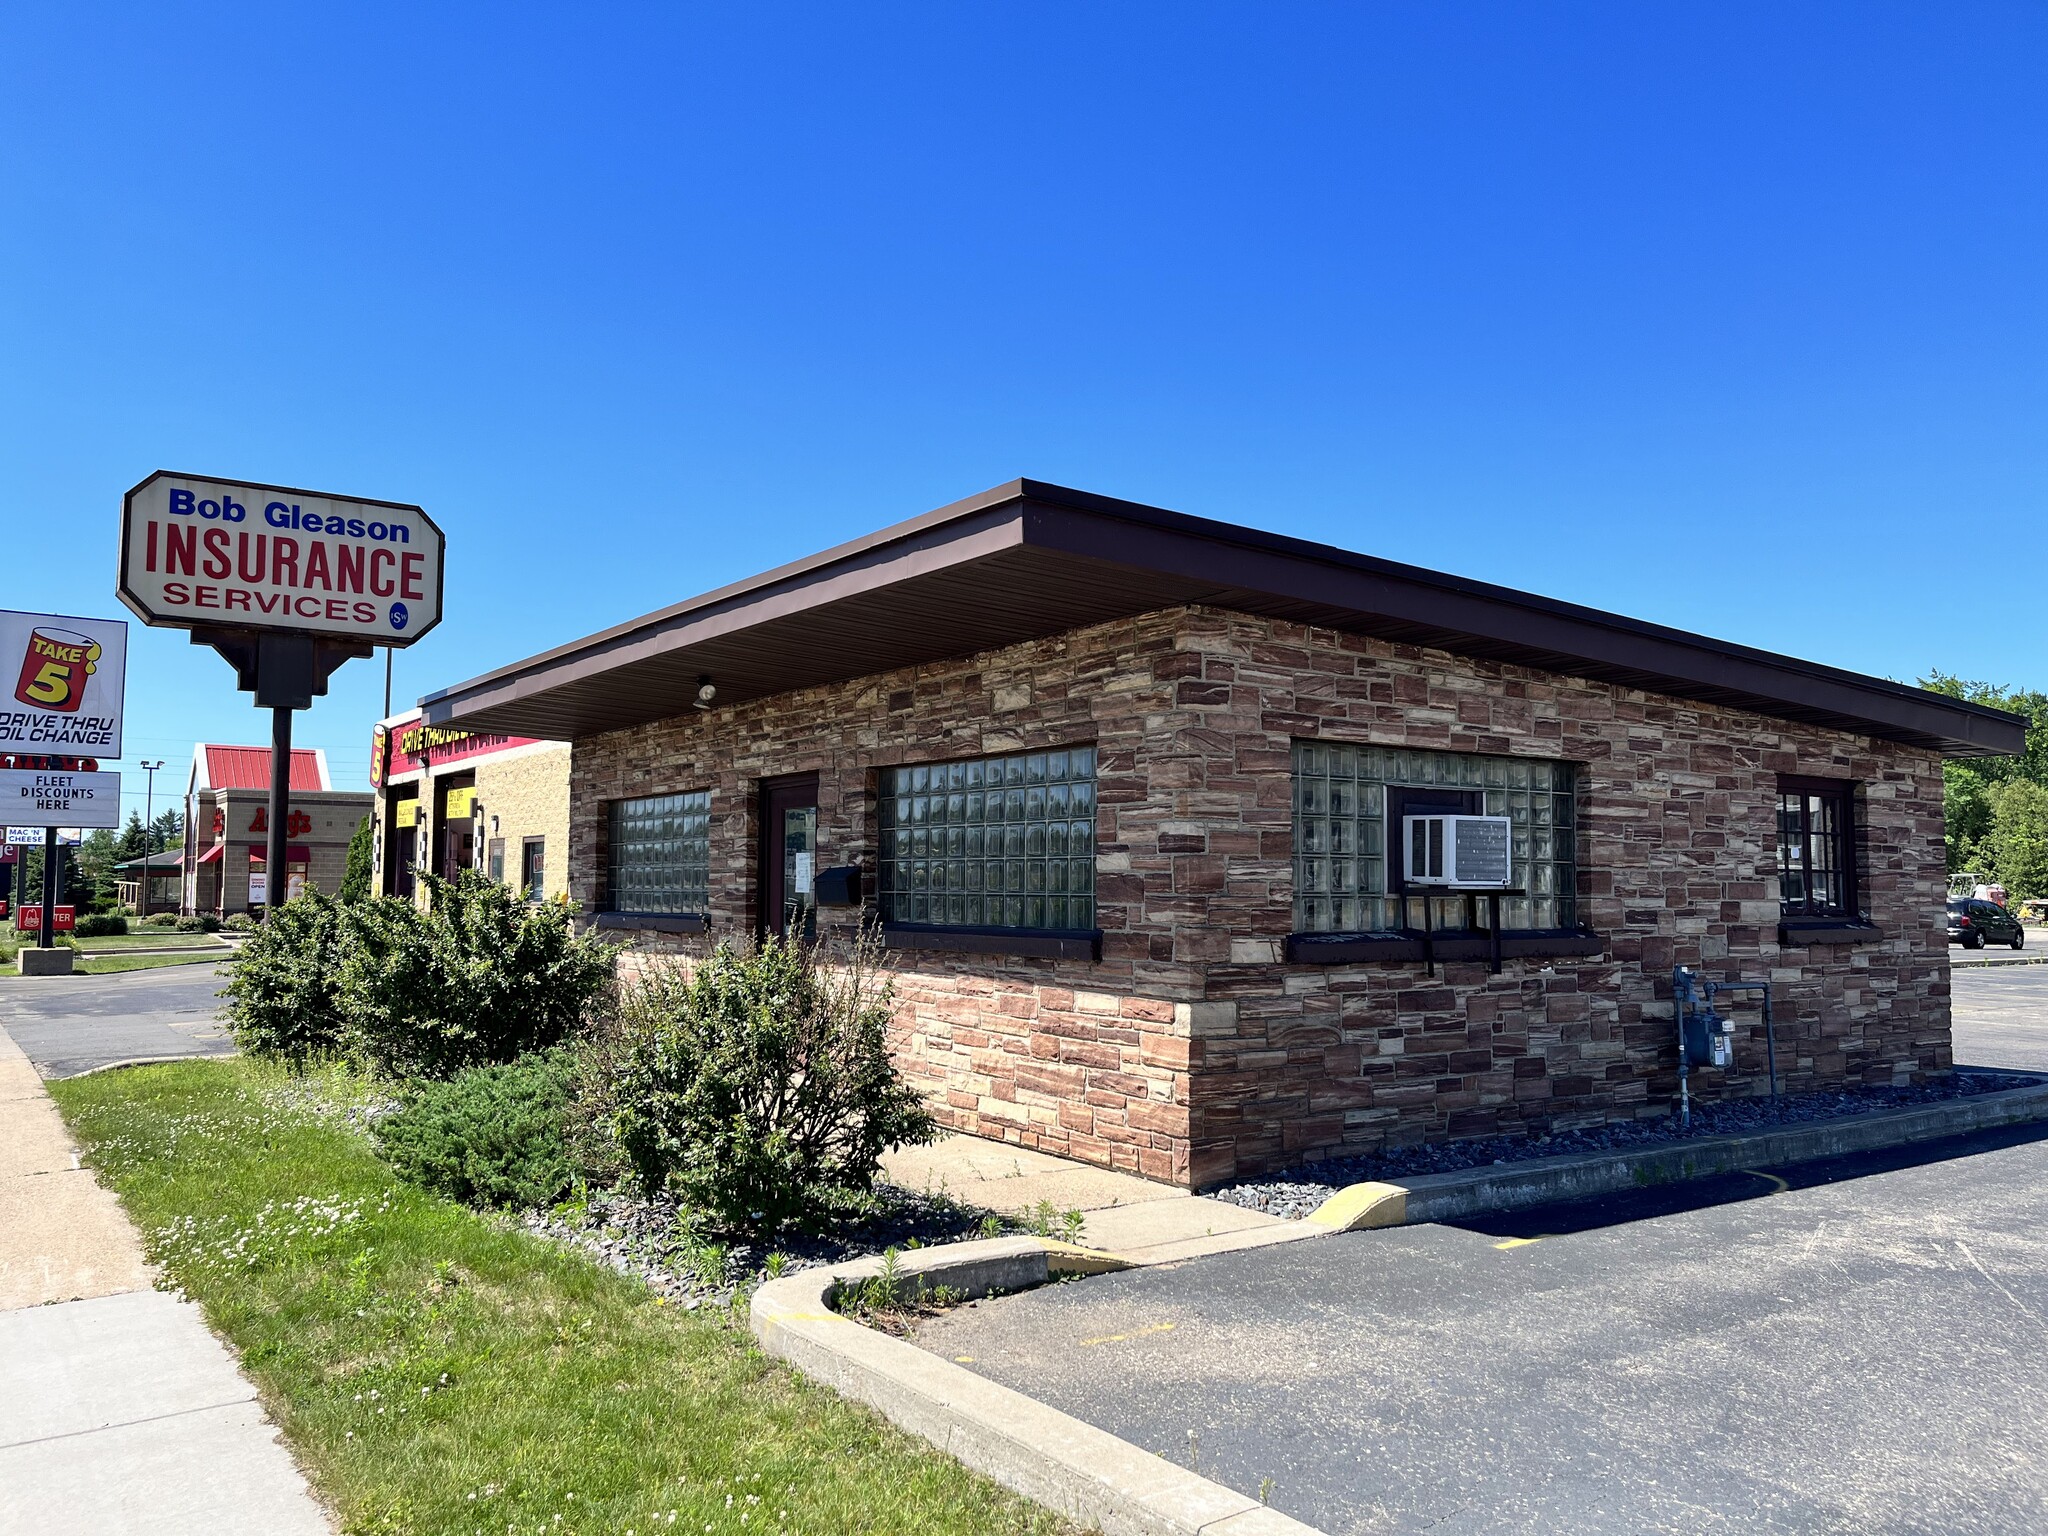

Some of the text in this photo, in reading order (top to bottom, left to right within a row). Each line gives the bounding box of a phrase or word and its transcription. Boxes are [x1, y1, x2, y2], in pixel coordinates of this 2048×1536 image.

[168, 488, 410, 543] Bob Gleason
[145, 520, 425, 600] INSURANCE
[162, 582, 377, 623] SERVICES
[33, 637, 84, 663] TAKE
[25, 661, 72, 706] 5
[0, 712, 114, 731] DRIVE THRU
[0, 726, 113, 745] OIL CHANGE
[401, 726, 424, 755] DRIVE
[371, 751, 382, 784] 5
[21, 787, 94, 799] DISCOUNTS
[36, 776, 74, 787] FLEET
[36, 799, 70, 810] HERE
[248, 807, 312, 838] Ay's
[54, 913, 71, 922] TER
